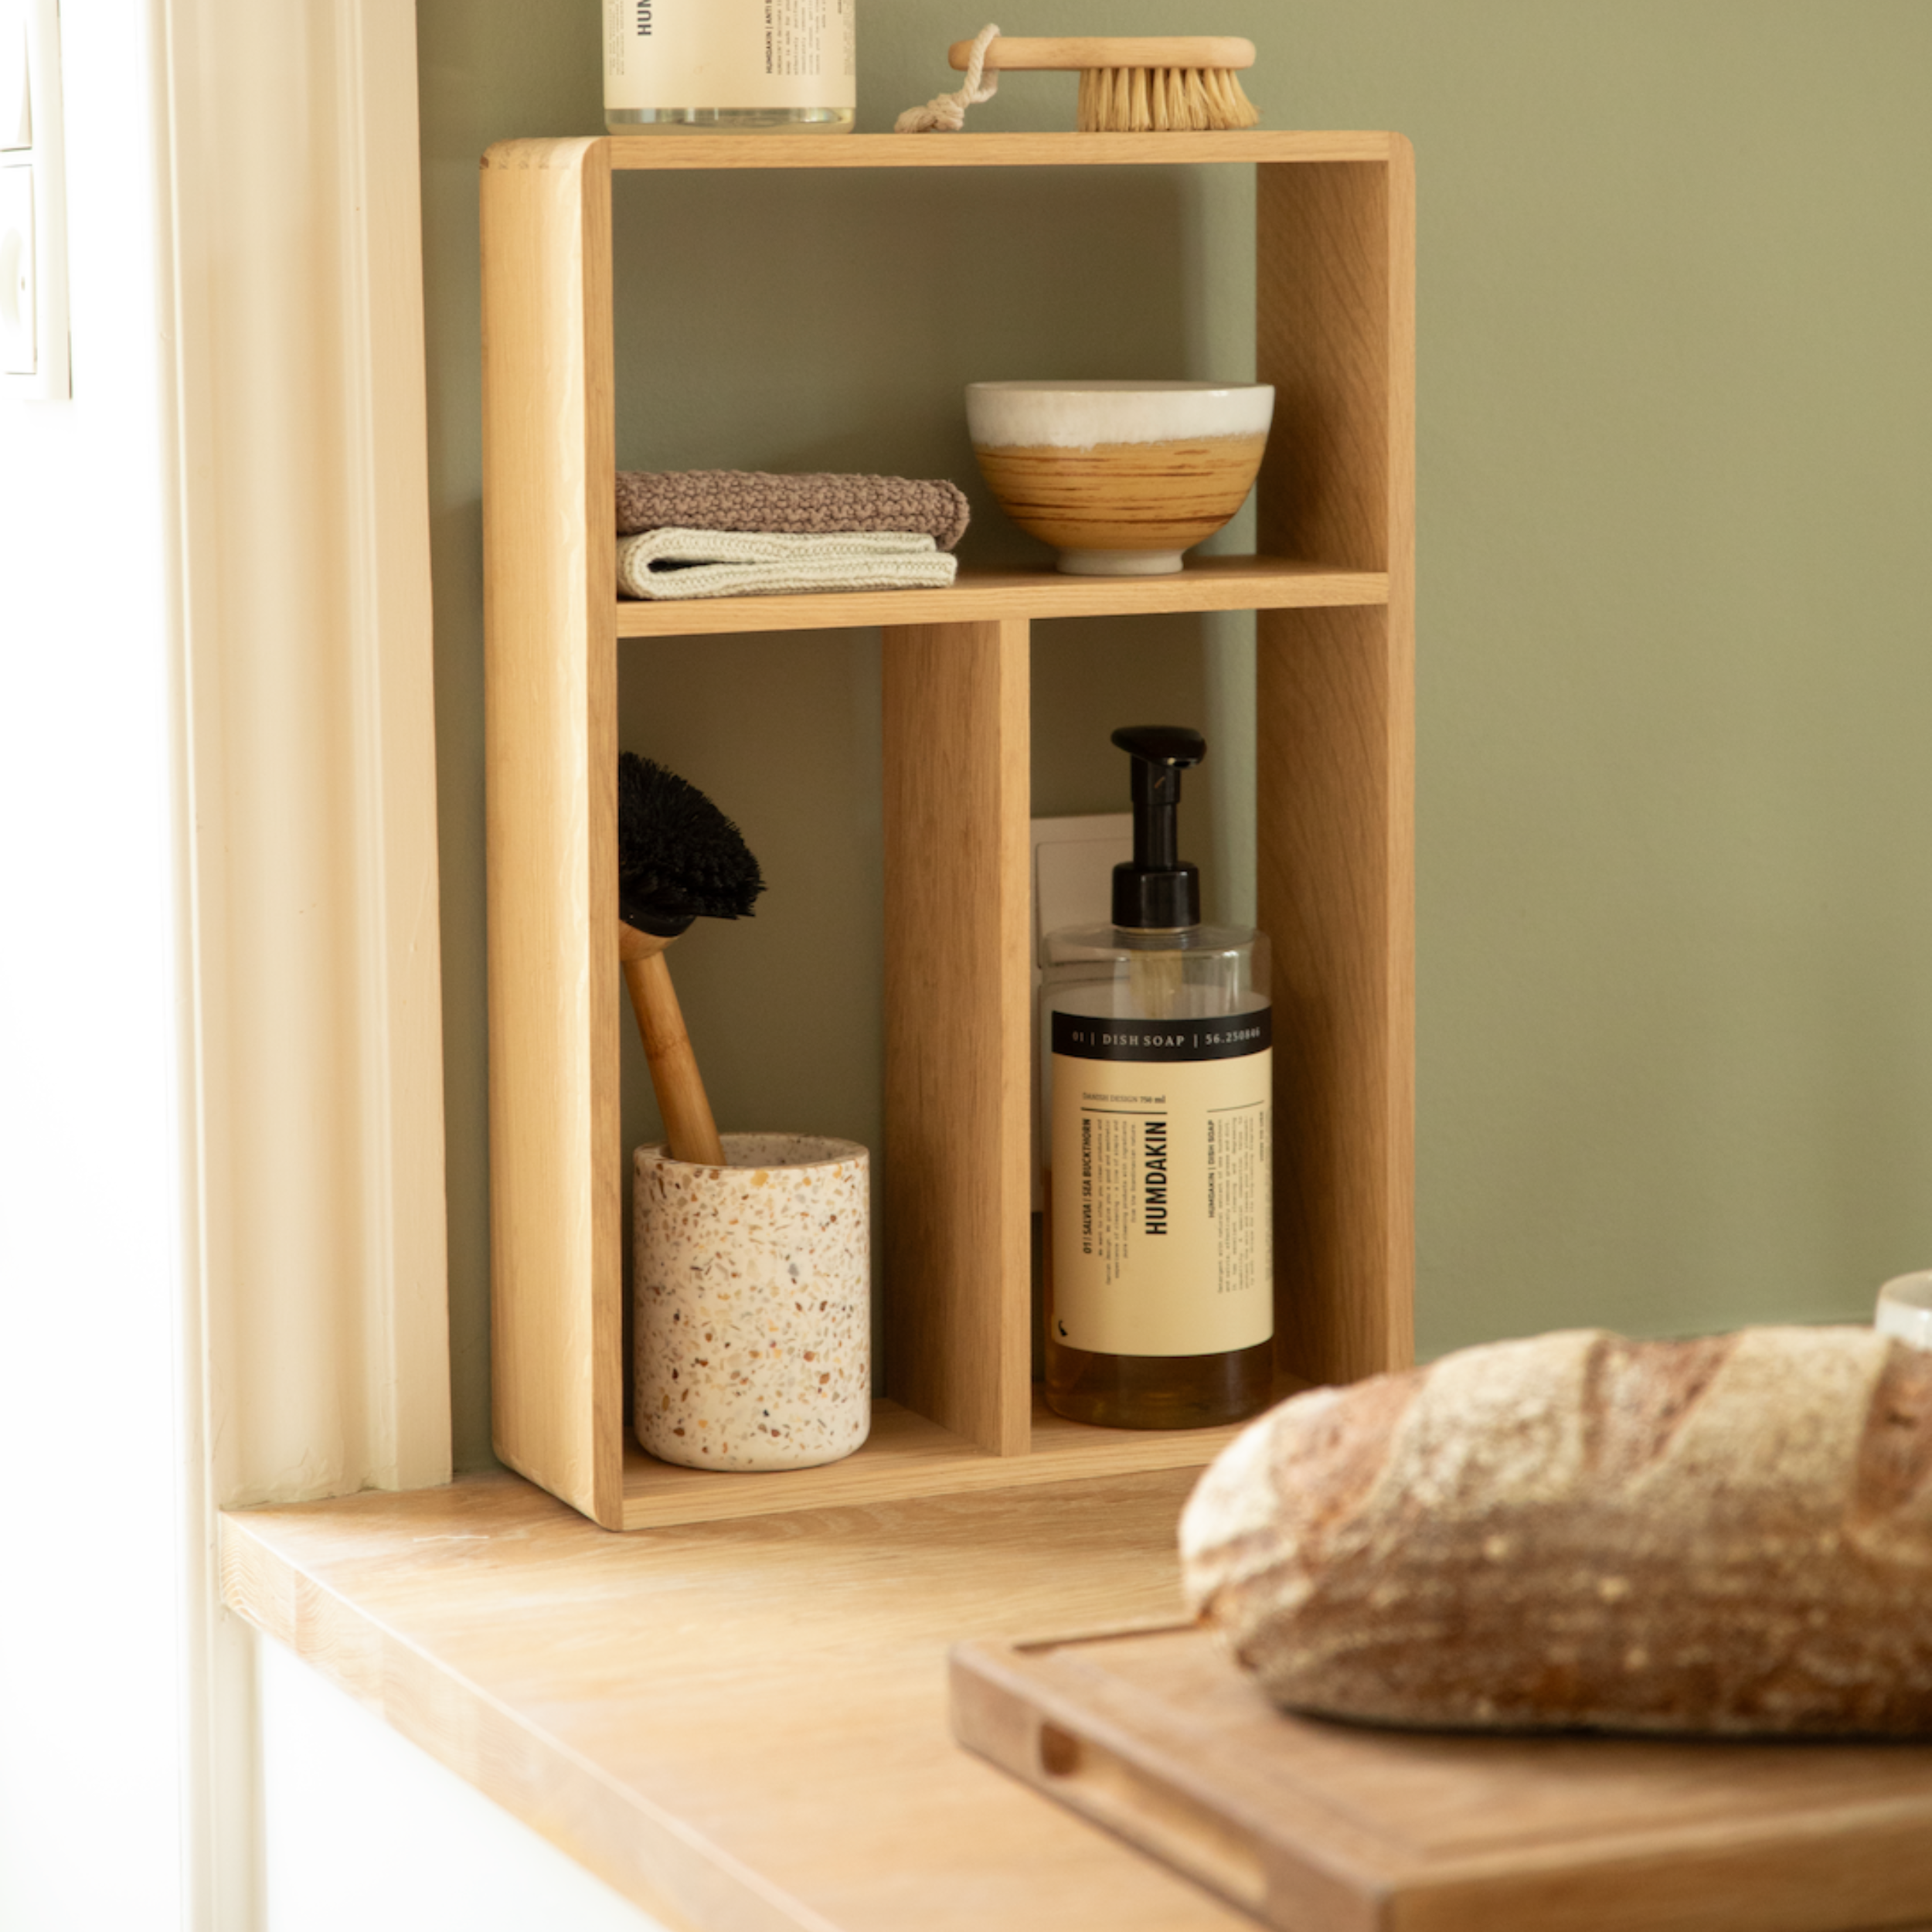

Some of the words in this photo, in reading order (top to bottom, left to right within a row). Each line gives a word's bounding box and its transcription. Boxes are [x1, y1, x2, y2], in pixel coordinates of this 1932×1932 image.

[1103, 1033, 1139, 1046] DISH
[1143, 1035, 1185, 1048] SOAP
[1082, 1119, 1091, 1177] BUCKTHORN
[1082, 1180, 1091, 1197] SEA
[1145, 1122, 1167, 1235] HUMDAKIN
[1083, 1204, 1092, 1236] SALVIA
